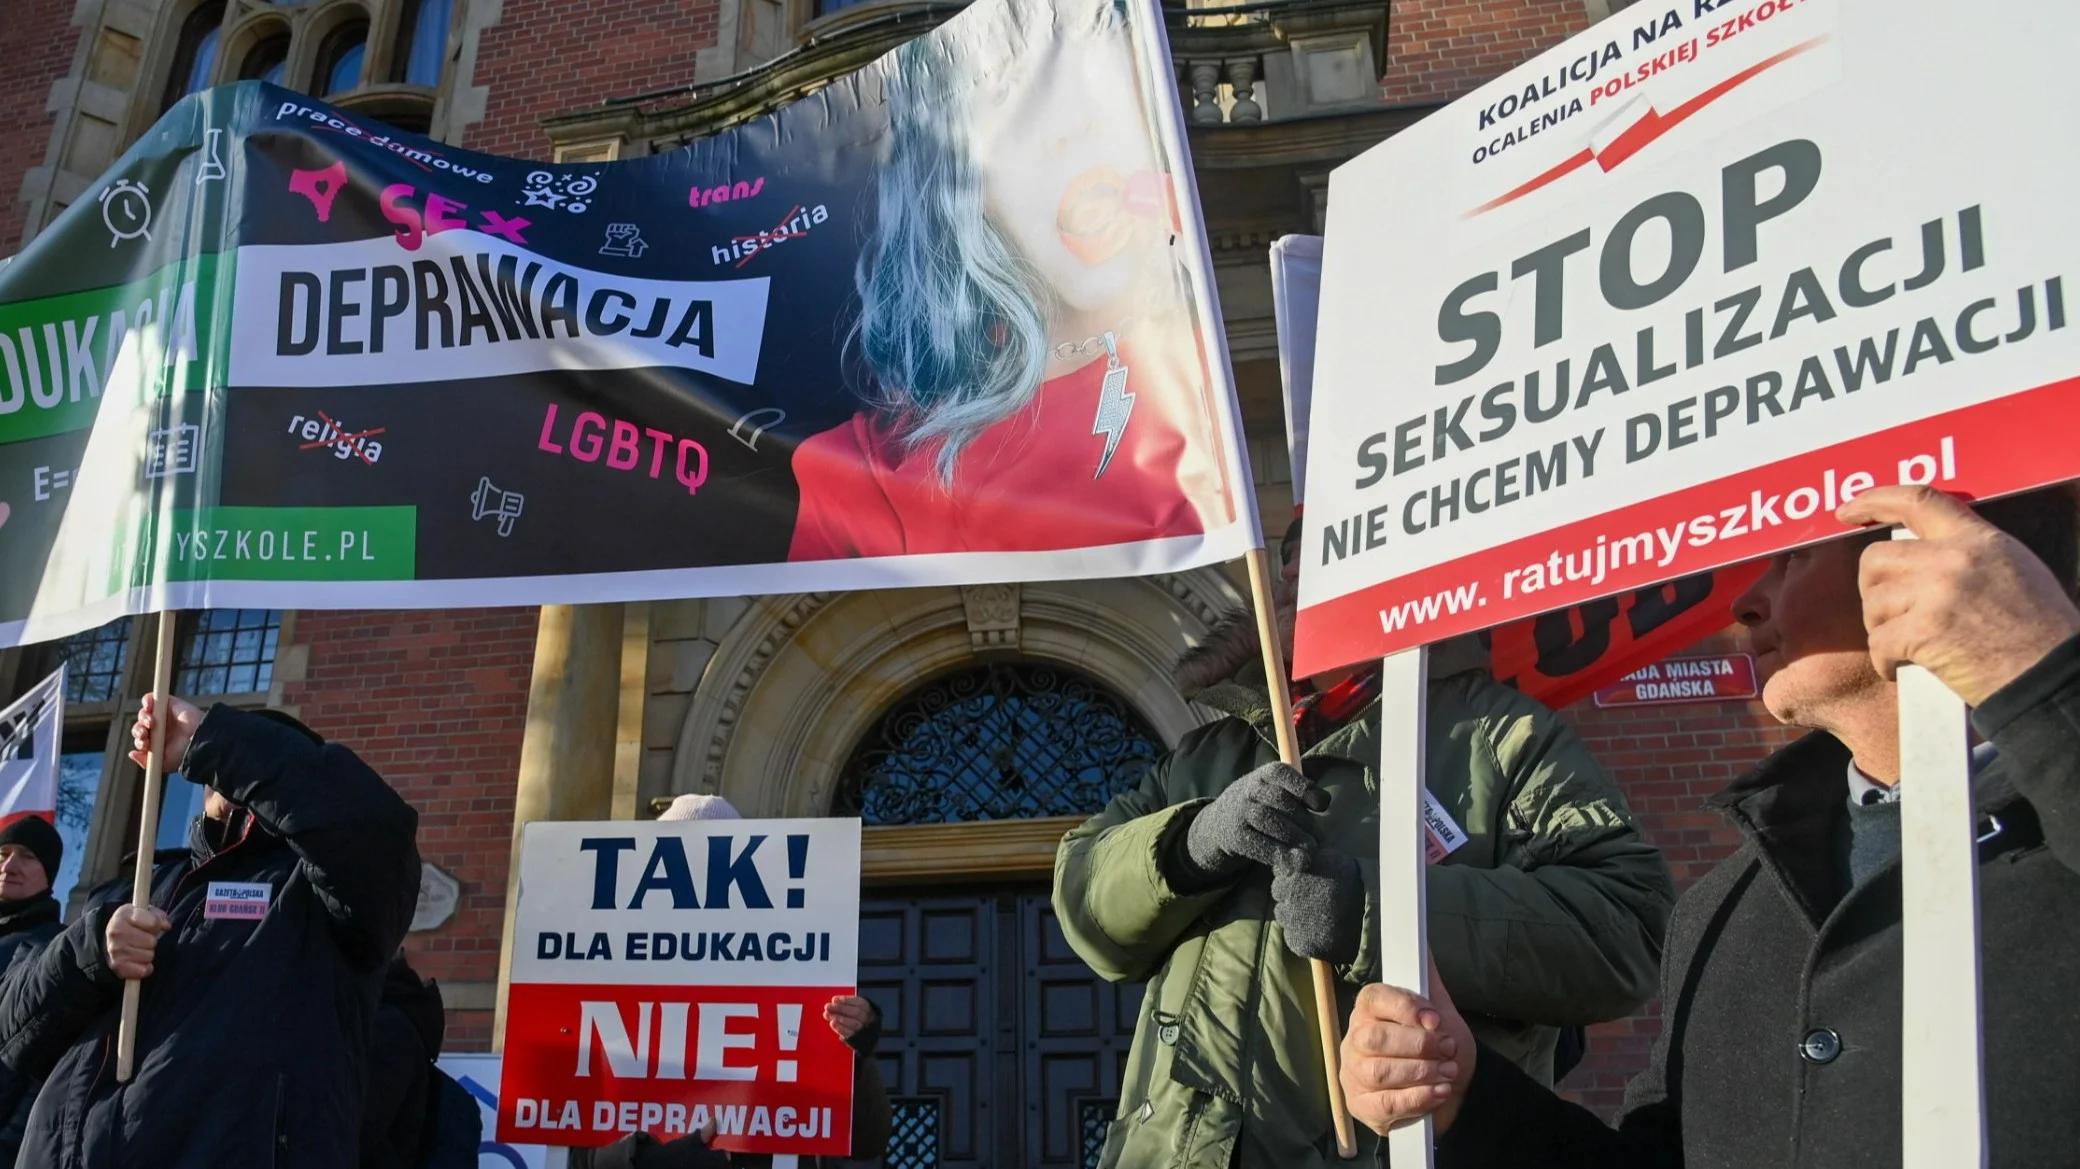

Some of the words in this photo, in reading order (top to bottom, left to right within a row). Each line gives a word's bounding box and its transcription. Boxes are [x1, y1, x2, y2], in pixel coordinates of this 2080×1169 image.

[1472, 98, 1583, 164] OCALENIA
[1590, 38, 1698, 106] POLSKIEJ
[1706, 0, 1807, 48] SZKOŁ
[1478, 40, 1622, 131] KOALICJA
[1633, 9, 1683, 51] NA
[276, 102, 362, 137] prace
[369, 136, 494, 184] domowe
[689, 177, 765, 208] trans
[712, 204, 829, 265] historia
[1434, 138, 1822, 386] STOP
[276, 253, 715, 359] DEPRAWACJA
[1355, 203, 1986, 490] SEKSUALIZACJI
[288, 415, 382, 463] religia
[538, 403, 709, 495] LGBTQ
[1320, 504, 1388, 566] NIE
[1402, 428, 1606, 535] CHCEMY
[1625, 275, 2066, 464] DEPRAWACJI
[1620, 664, 1661, 682] DA
[1666, 660, 1734, 678] MIASTA
[580, 834, 810, 910] TAK!
[537, 932, 612, 961] DLA
[625, 932, 830, 962] EDUKACJI
[575, 1001, 803, 1083] NIE!
[515, 1098, 582, 1131] DLA
[592, 1101, 832, 1138] DEPRAWACJI
